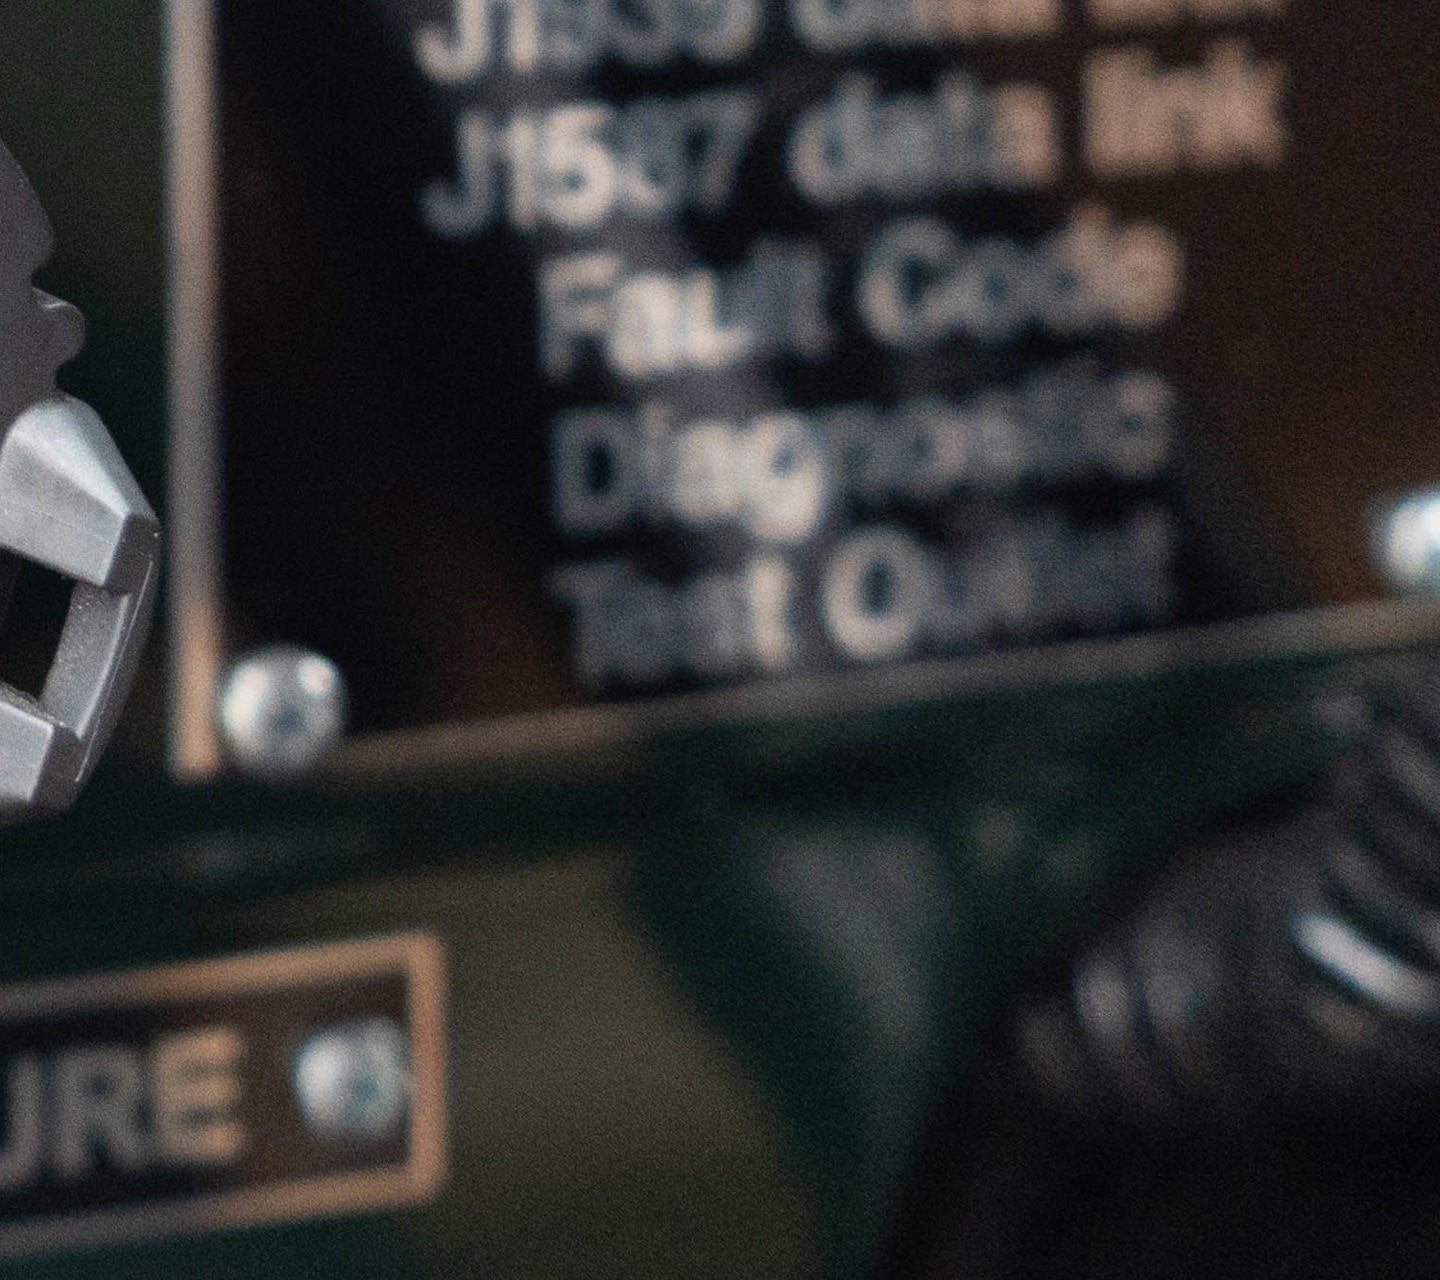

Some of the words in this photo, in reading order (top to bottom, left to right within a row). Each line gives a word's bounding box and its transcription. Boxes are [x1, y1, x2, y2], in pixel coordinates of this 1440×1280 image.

[787, 72, 1056, 204] data
[1086, 44, 1282, 175] link
[537, 238, 831, 382] Fault
[857, 206, 1181, 340] Code
